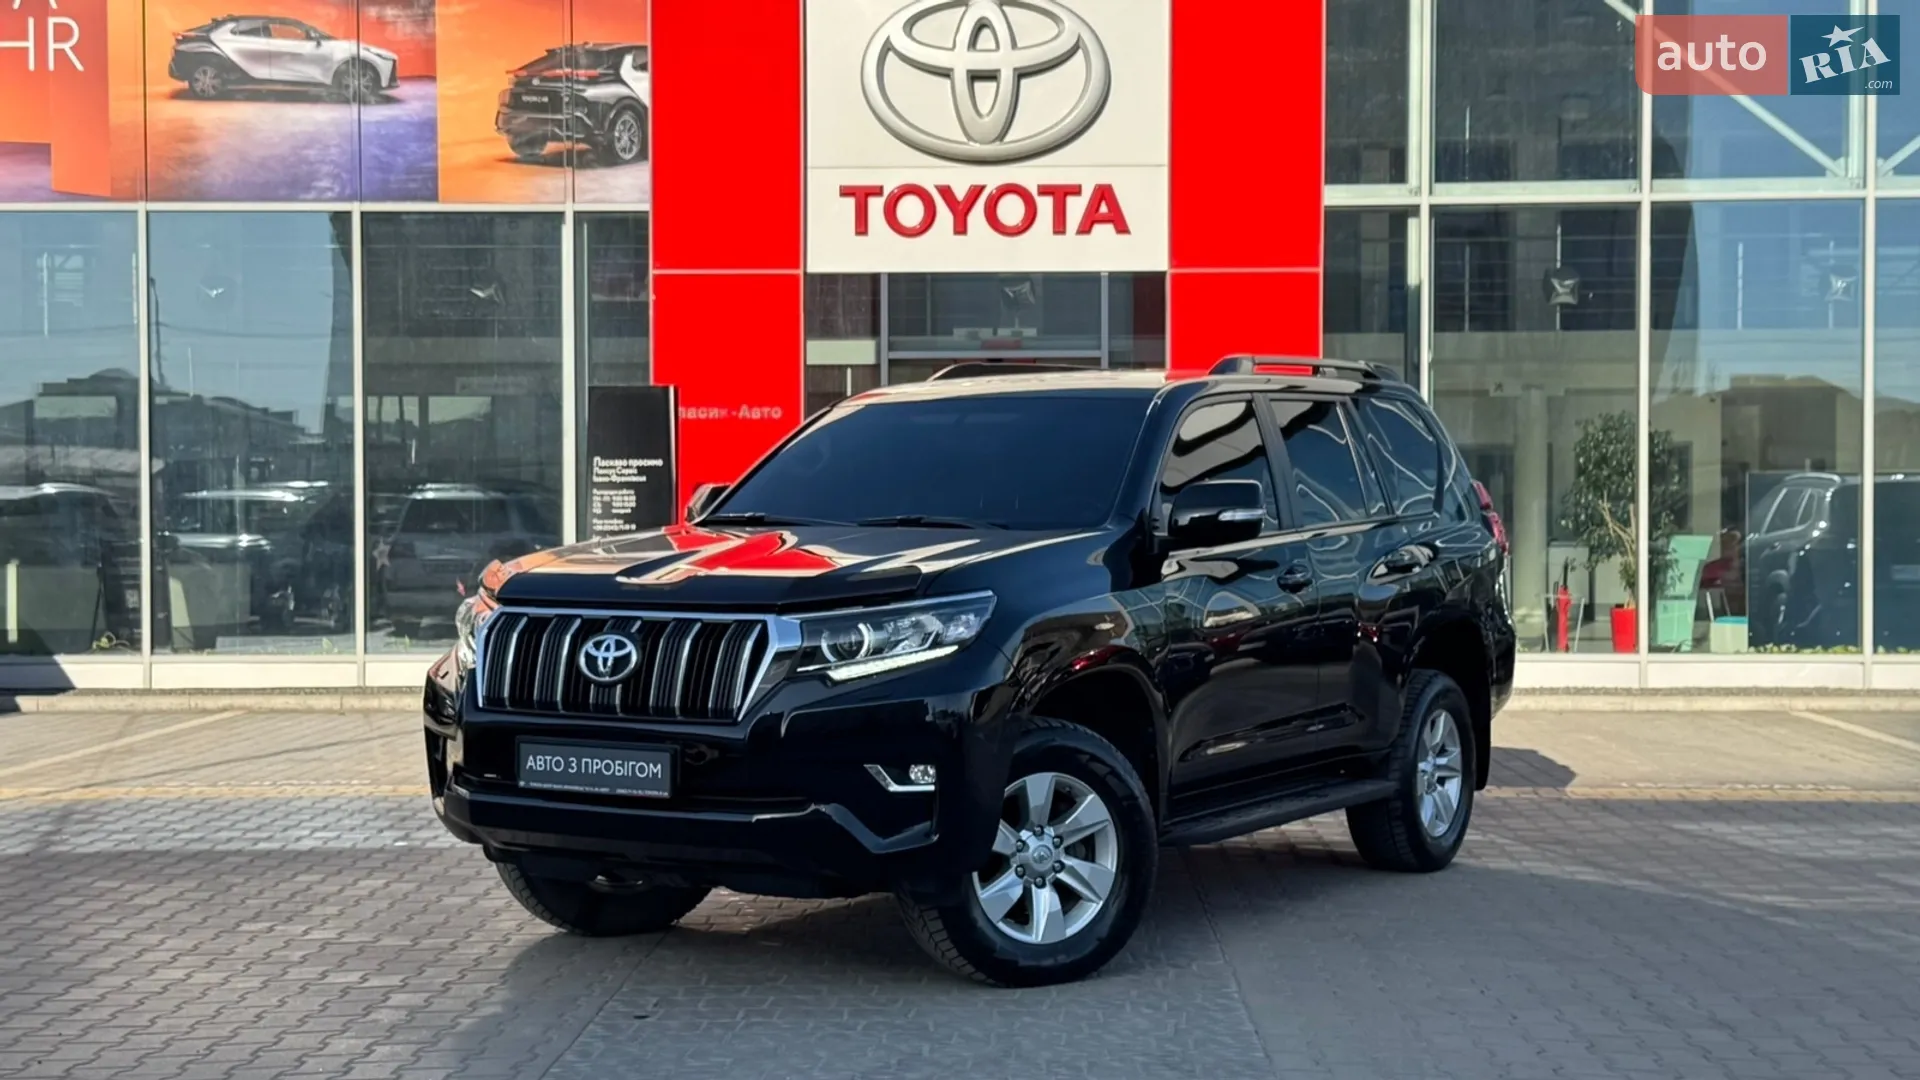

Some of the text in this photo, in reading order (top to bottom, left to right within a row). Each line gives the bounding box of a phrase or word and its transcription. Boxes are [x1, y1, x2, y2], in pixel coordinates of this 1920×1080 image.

[839, 182, 1132, 239] TOYOTA
[526, 754, 565, 773] АВТО
[581, 758, 662, 779] ПРОБІГОМ
